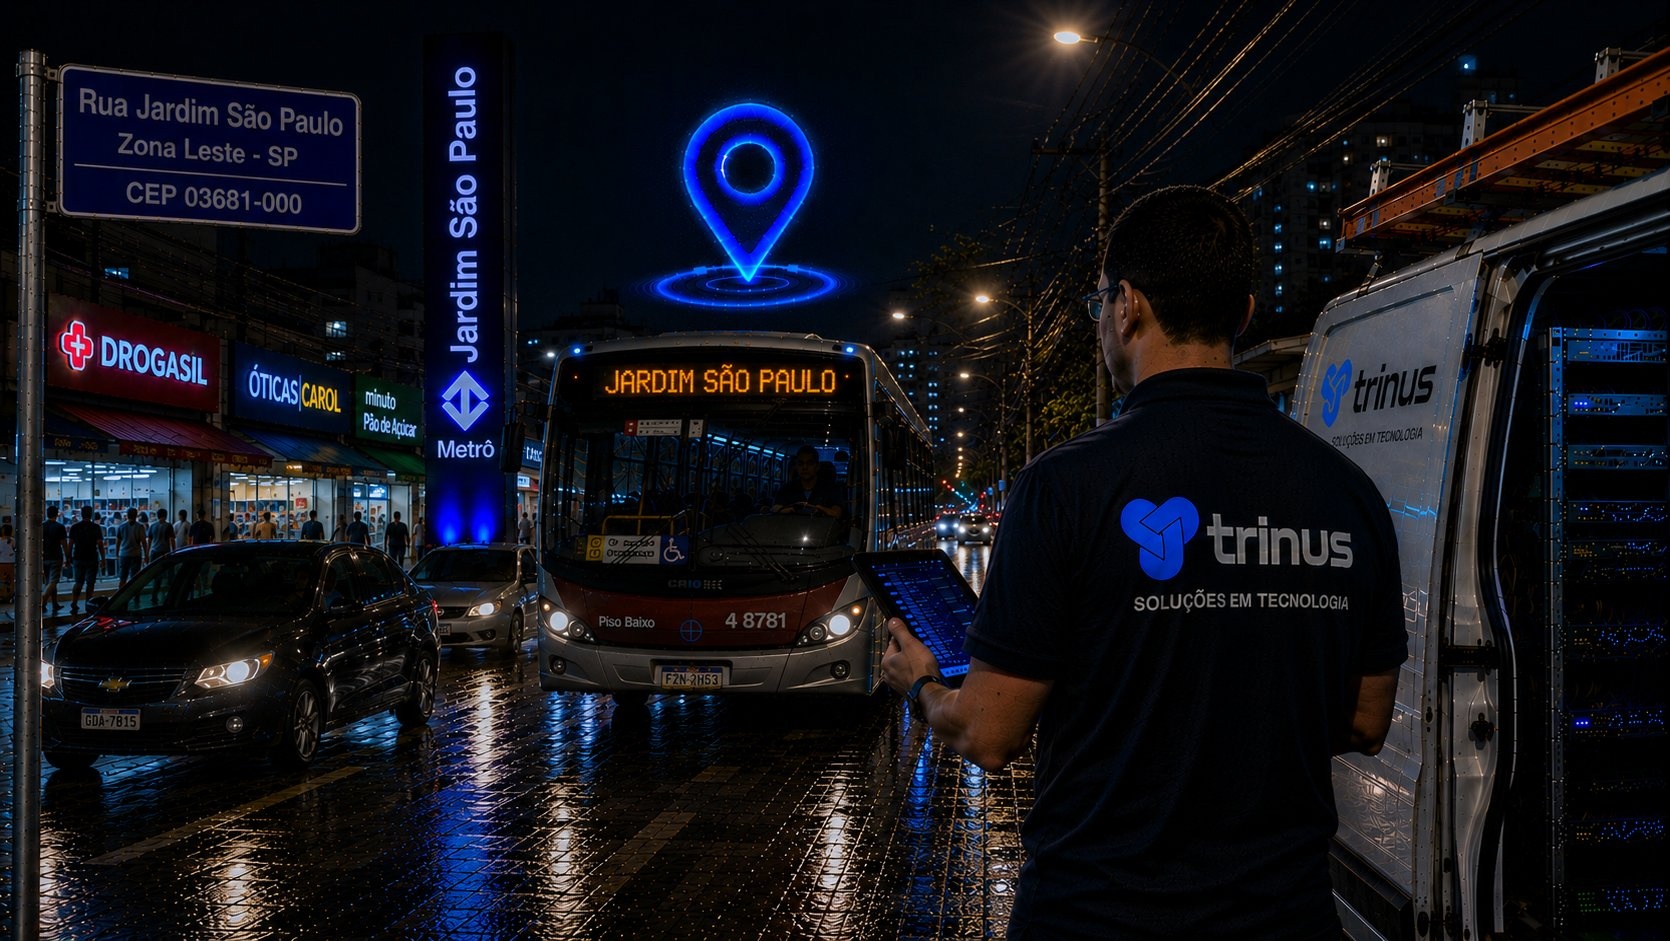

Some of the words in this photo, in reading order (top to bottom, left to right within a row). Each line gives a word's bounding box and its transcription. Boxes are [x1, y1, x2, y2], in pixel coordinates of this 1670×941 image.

[79, 88, 128, 118] Rua
[136, 94, 219, 126] Jardim
[227, 102, 272, 130] São
[280, 107, 344, 137] Paulo
[448, 66, 476, 162] Paulo
[118, 132, 176, 159] Zona
[184, 138, 246, 164] Leste
[268, 146, 298, 167] SP
[126, 181, 177, 205] CEP
[184, 186, 302, 214] 03681-000
[449, 174, 478, 238] São
[450, 251, 478, 363] Jardim
[101, 335, 208, 386] DROGASIL
[249, 364, 299, 405] ÓTICAS
[301, 382, 342, 413] CAROL
[605, 369, 694, 394] JARDIM
[703, 363, 750, 394] SÃO
[759, 369, 836, 394] PAULO
[1353, 363, 1437, 414] trinus
[365, 388, 397, 411] minuto
[363, 412, 379, 432] Pão
[380, 415, 391, 434] de
[391, 417, 418, 440] Açúcar
[1377, 427, 1423, 444] TECNOLOGIA
[437, 439, 496, 459] Metrô
[1206, 513, 1354, 569] trinus
[1134, 588, 1226, 613] SOLUÇÕES
[1229, 593, 1252, 608] EM
[1257, 592, 1350, 611] TECNOLOGIA
[599, 615, 622, 628] Piso
[624, 616, 656, 629] Baixo
[725, 612, 737, 629] 4
[743, 612, 786, 629] 8781
